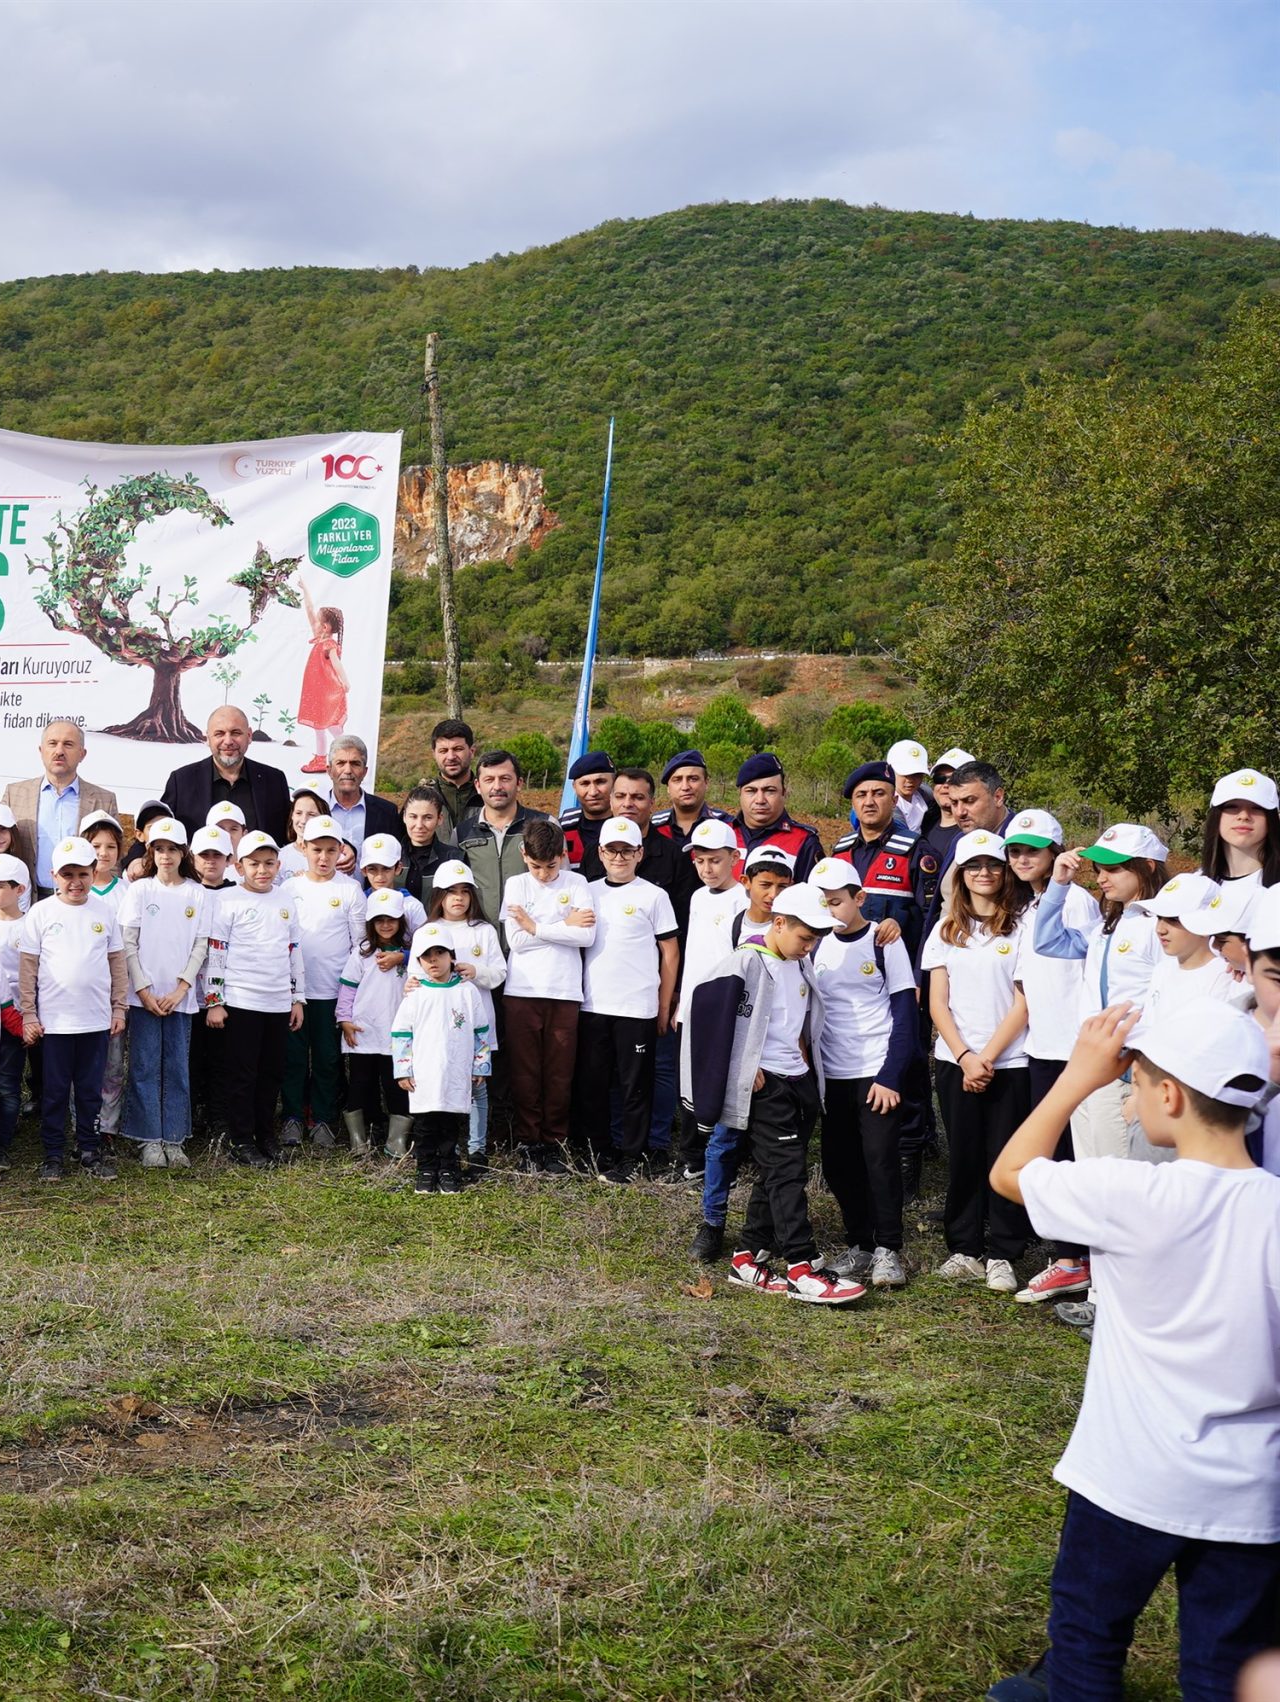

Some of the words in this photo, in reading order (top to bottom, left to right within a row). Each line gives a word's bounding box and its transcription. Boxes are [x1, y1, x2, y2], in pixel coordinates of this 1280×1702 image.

[331, 517, 357, 531] 2023
[317, 531, 350, 543] FARKLI
[352, 530, 372, 541] YER
[316, 543, 375, 558] Milyonlarca
[331, 553, 360, 566] Fidan
[22, 656, 93, 679] Kuruyoruz
[3, 712, 33, 729] fidan
